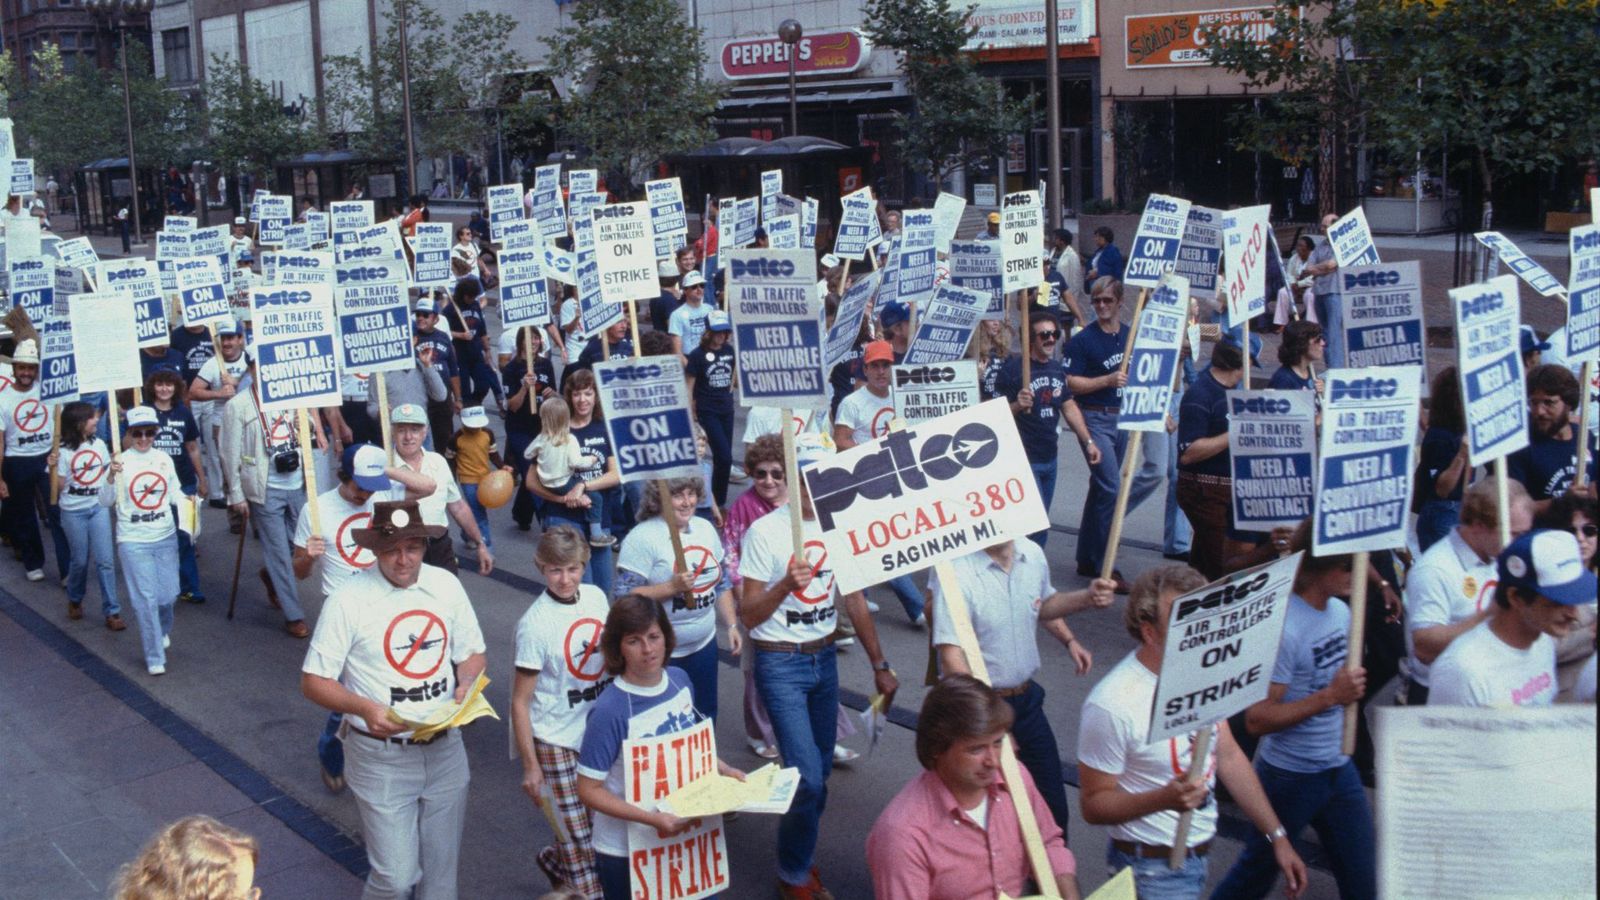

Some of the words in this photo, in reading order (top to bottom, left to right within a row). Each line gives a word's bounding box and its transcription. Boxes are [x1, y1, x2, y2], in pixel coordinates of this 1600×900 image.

[999, 10, 1045, 24] CORNED
[1001, 28, 1028, 38] SALAMI
[1004, 193, 1032, 209] patco
[1147, 199, 1177, 213] patco
[593, 205, 634, 221] patco
[1156, 217, 1180, 228] TRAFFIC
[267, 221, 283, 231] ON
[600, 224, 612, 233] AIR
[616, 221, 643, 232] TRAFFIC
[1014, 232, 1028, 245] ON
[1143, 239, 1165, 257] ON
[500, 251, 534, 264] patco
[613, 243, 633, 257] ON
[12, 260, 43, 272] patco
[176, 260, 208, 271] patco
[279, 256, 320, 267] patco
[731, 257, 795, 279] patco
[1006, 256, 1038, 273] STRIKE
[1129, 259, 1174, 277] STRIKE
[1230, 222, 1262, 315] PATCO
[107, 268, 147, 283] patco
[336, 266, 389, 284] patco
[604, 268, 650, 285] STRIKE
[1344, 270, 1400, 291] patco
[20, 291, 41, 306] ON
[192, 287, 213, 301] ON
[254, 290, 312, 309] patco
[345, 287, 361, 298] AIR
[365, 284, 399, 297] TRAFFIC
[511, 285, 530, 299] NEED
[741, 287, 757, 301] AIR
[764, 287, 806, 301] TRAFFIC
[935, 287, 977, 306] patco
[1352, 296, 1367, 307] AIR
[1372, 292, 1411, 306] TRAFFIC
[187, 301, 229, 320] STRIKE
[263, 313, 278, 324] AIR
[285, 311, 323, 322] TRAFFIC
[355, 313, 385, 330] NEED
[385, 311, 396, 326] A
[344, 325, 409, 348] SURVIVABLE
[754, 327, 786, 348] NEED
[787, 327, 802, 346] A
[929, 328, 949, 340] NEED
[949, 330, 959, 341] A
[1362, 327, 1394, 348] NEED
[1394, 325, 1405, 344] A
[274, 341, 306, 363] NEED
[306, 338, 319, 357] A
[350, 341, 407, 364] CONTRACT
[913, 341, 965, 354] SURVIVABLE
[1348, 342, 1423, 368] SURVIVABLE
[50, 358, 70, 376] ON
[261, 354, 335, 382] SURVIVABLE
[741, 348, 820, 371] SURVIVABLE
[1136, 352, 1163, 383] ON
[600, 364, 661, 384] patco
[748, 369, 819, 393] CONTRACT
[895, 366, 956, 387] patco
[41, 375, 78, 397] STRIKE
[267, 372, 333, 399] CONTRACT
[612, 388, 629, 399] AIR
[634, 384, 675, 398] TRAFFIC
[1330, 376, 1398, 403] patco
[905, 393, 921, 406] AIR
[925, 391, 968, 405] TRAFFIC
[1120, 386, 1169, 416] STRIKE
[1231, 396, 1291, 415] patco
[630, 415, 670, 441] ON
[1338, 412, 1356, 427] AIR
[1363, 410, 1405, 426] TRAFFIC
[1240, 423, 1255, 435] AIR
[1260, 423, 1302, 435] TRAFFIC
[620, 437, 698, 469] STRIKE
[1250, 456, 1283, 478] NEED
[1284, 456, 1296, 476] A
[1342, 456, 1381, 484] NEED
[1381, 452, 1393, 477] A
[805, 422, 999, 533] patco
[1235, 476, 1313, 498] SURVIVABLE
[1321, 476, 1407, 512] SURVIVABLE
[847, 500, 957, 556] LOCAL
[965, 477, 1025, 517] 380
[1242, 497, 1310, 518] CONTRACT
[1326, 501, 1400, 538] CONTRACT
[882, 529, 967, 571] SAGINAW
[976, 518, 1003, 541] MI.
[1177, 572, 1269, 621] patco
[785, 605, 835, 628] patco
[1184, 620, 1210, 637] AIR
[1220, 592, 1277, 627] TRAFFIC
[1179, 606, 1273, 652] CONTROLLERS
[1201, 638, 1243, 668] ON
[390, 678, 448, 706] patco
[1165, 663, 1263, 716] STRIKE
[1164, 712, 1199, 730] LOCAL
[632, 727, 713, 803] PATCO
[632, 828, 724, 900] STRIKE
